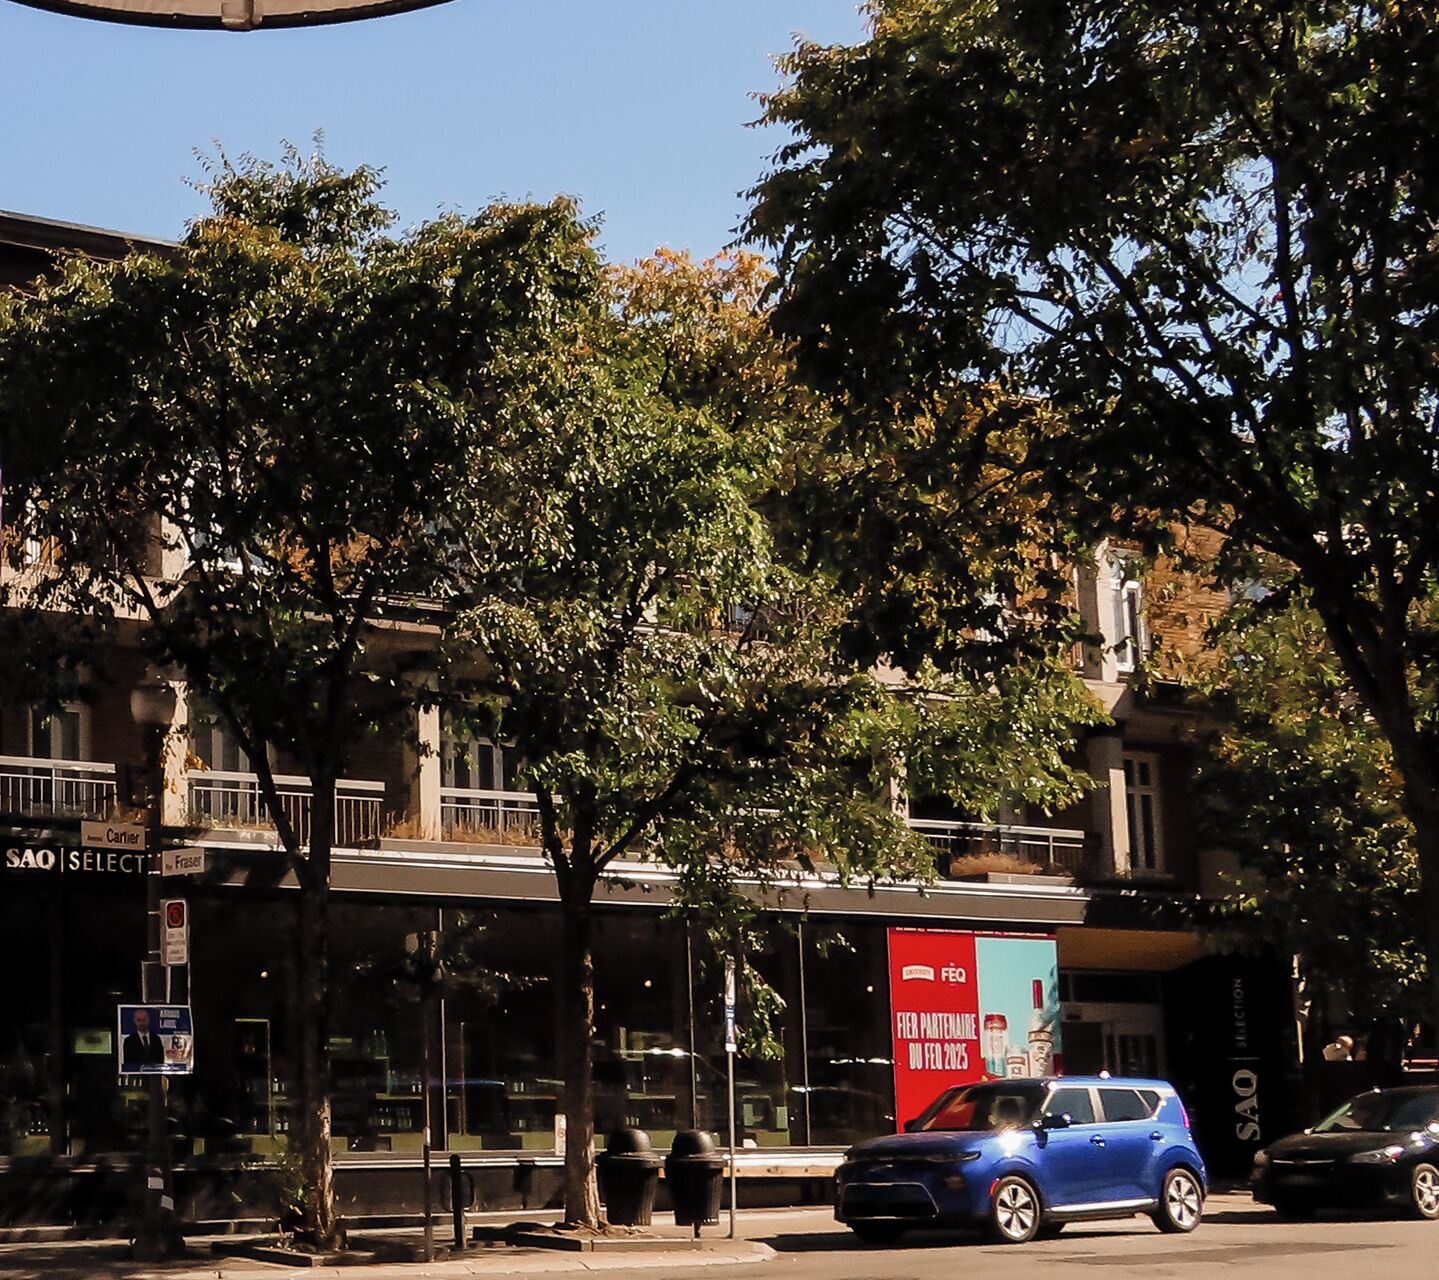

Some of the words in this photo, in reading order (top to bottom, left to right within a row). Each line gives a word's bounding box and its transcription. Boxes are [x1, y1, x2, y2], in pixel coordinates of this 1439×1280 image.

[106, 828, 140, 845] Cartier
[6, 848, 56, 871] SAQ
[68, 849, 146, 874] SÉLECT
[175, 854, 202, 870] Fraser
[896, 1012, 919, 1040] FIER
[920, 1012, 978, 1040] PARTENAIRE
[909, 1042, 923, 1070] DU
[924, 1042, 941, 1070] FEQ
[943, 1042, 969, 1070] 2025
[1232, 1069, 1261, 1142] SAQ
